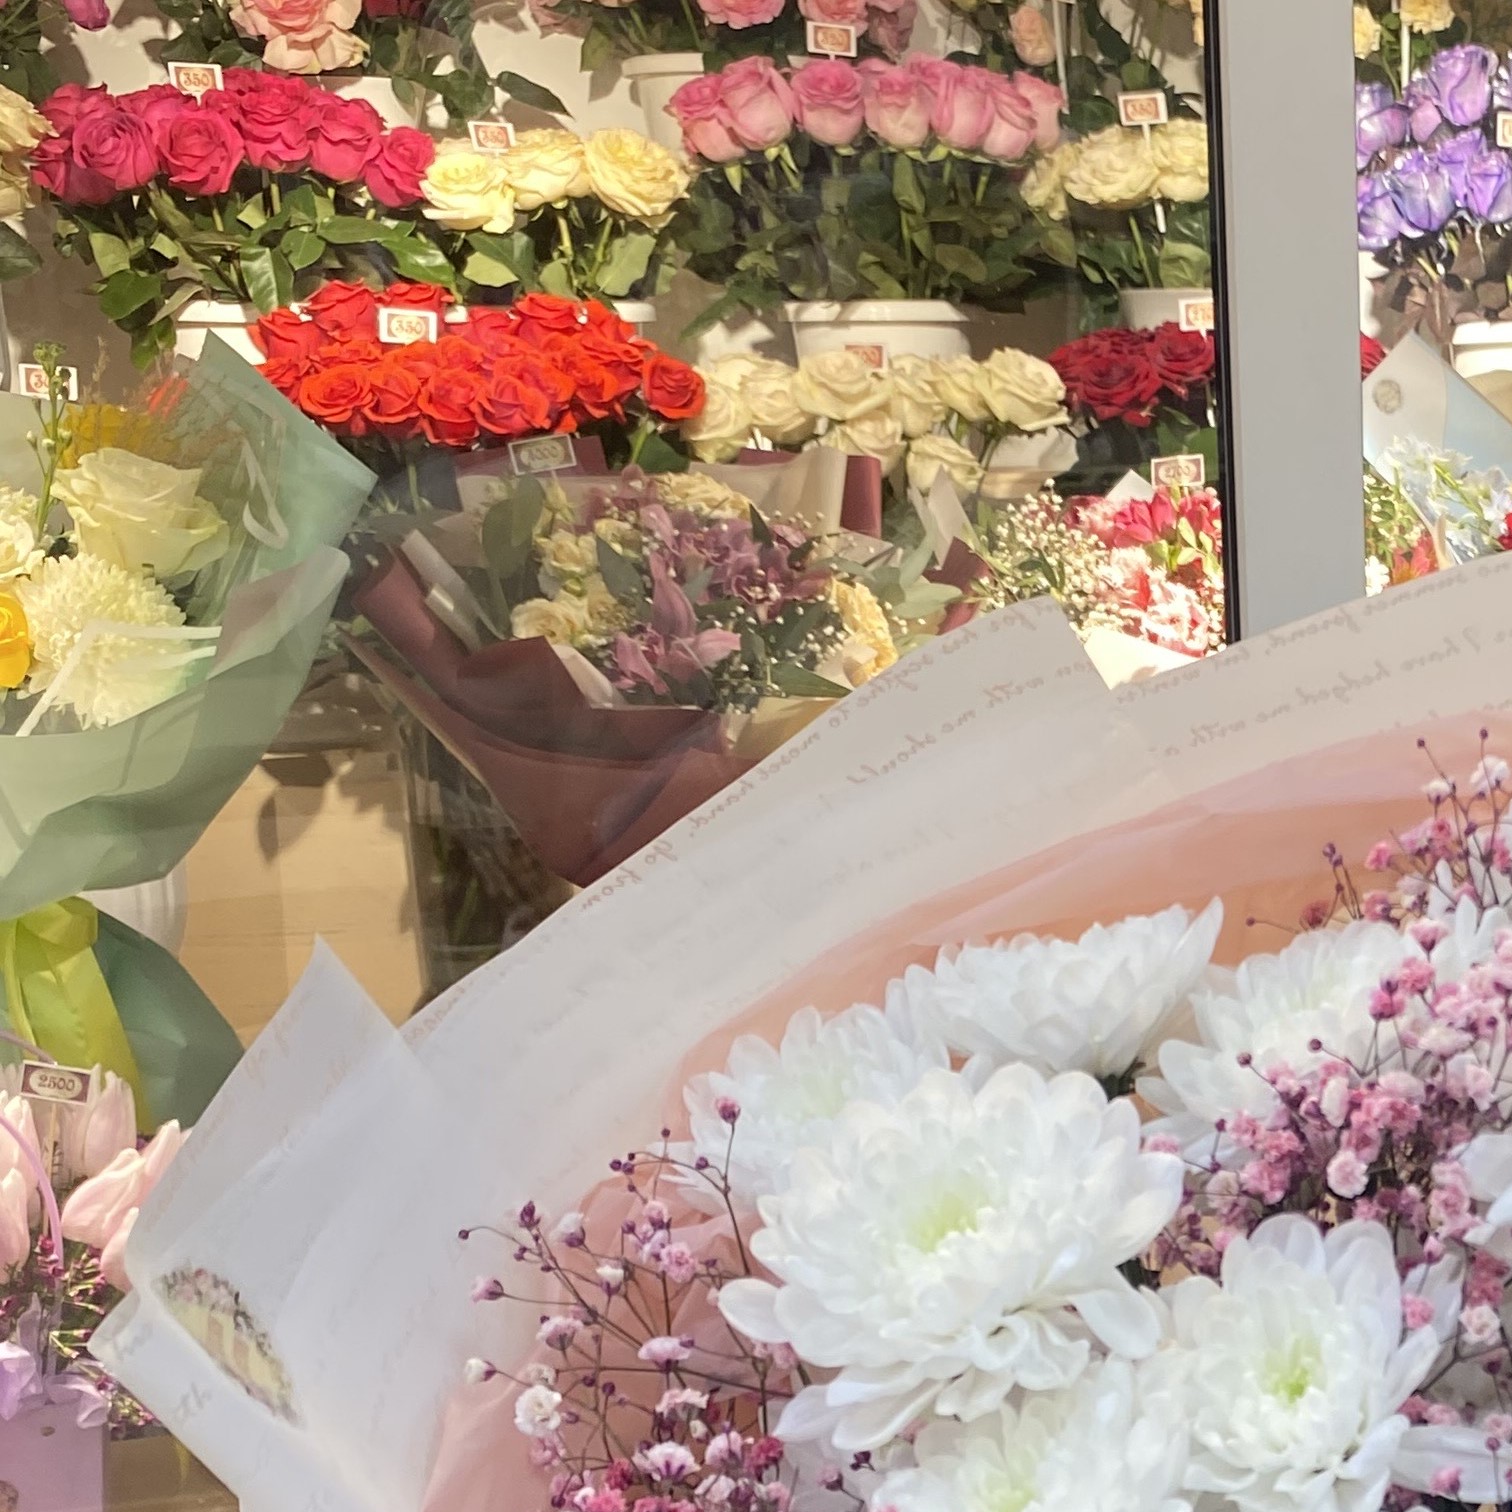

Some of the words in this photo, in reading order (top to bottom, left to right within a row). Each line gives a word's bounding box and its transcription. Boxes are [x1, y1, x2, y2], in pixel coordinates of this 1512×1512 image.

[183, 70, 209, 85] 350
[395, 317, 423, 333] 350
[37, 1074, 76, 1092] 2500
